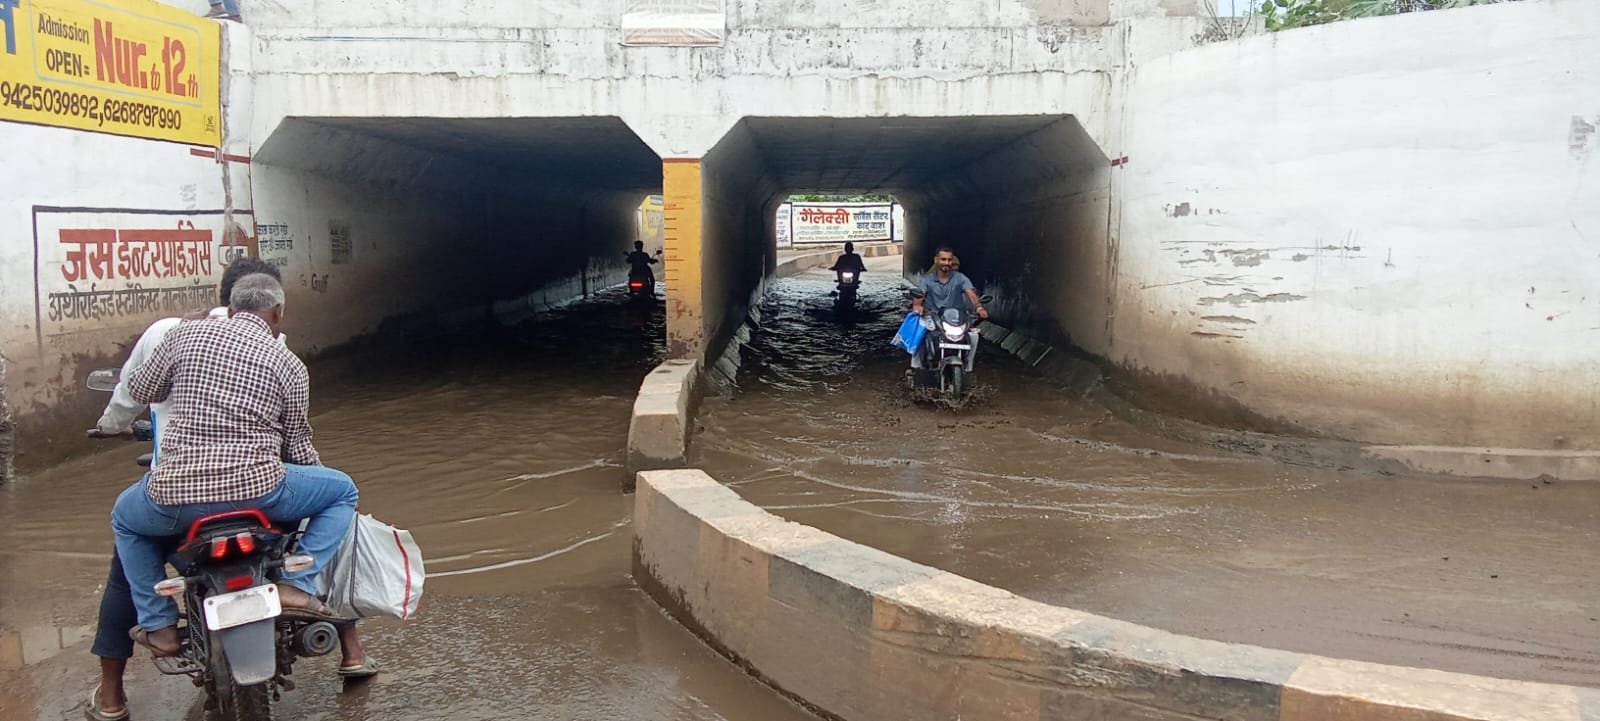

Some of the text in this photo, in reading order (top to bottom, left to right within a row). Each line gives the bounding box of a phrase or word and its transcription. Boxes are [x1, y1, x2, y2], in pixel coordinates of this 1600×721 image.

[38, 13, 89, 45] Admission
[93, 17, 147, 89] Nur.
[150, 63, 161, 90] to
[800, 208, 850, 224] गैलेक्सी
[59, 229, 117, 282] जस
[114, 282, 160, 317] स्टॉकिस्ट
